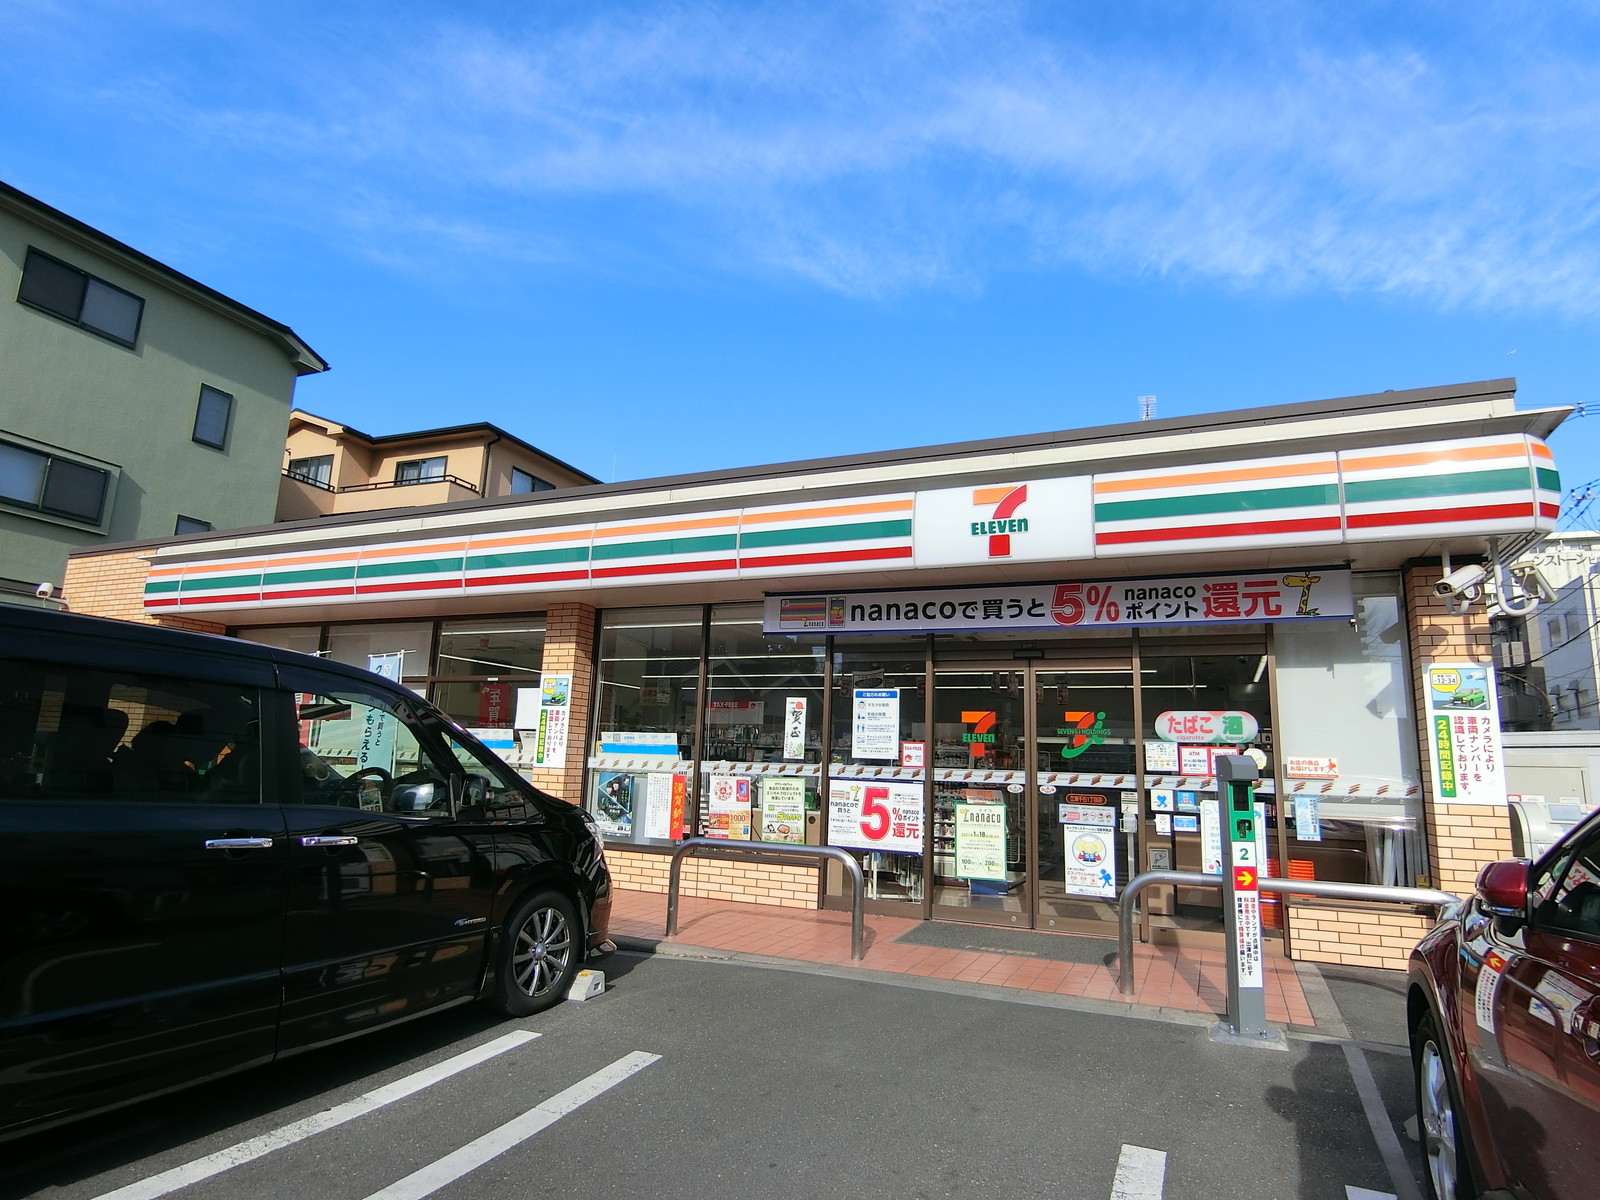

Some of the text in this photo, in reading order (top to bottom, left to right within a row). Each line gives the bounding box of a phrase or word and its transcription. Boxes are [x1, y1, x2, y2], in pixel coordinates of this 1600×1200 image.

[1124, 585, 1196, 600] nanaco
[1202, 580, 1283, 618] 還元
[850, 582, 1120, 626] nanacoで買うと 5%
[1125, 601, 1199, 620] ポイント
[1168, 715, 1213, 735] たばこ
[1222, 715, 1244, 735] 酒
[1467, 716, 1482, 781] 車両ナンバーを
[1481, 716, 1495, 773] カメラにより
[1436, 719, 1454, 792] 24時間記録中
[1453, 716, 1472, 795] 認識しております。
[969, 812, 1001, 824] nanaco
[892, 822, 919, 839] 還元
[1239, 848, 1249, 860] 2
